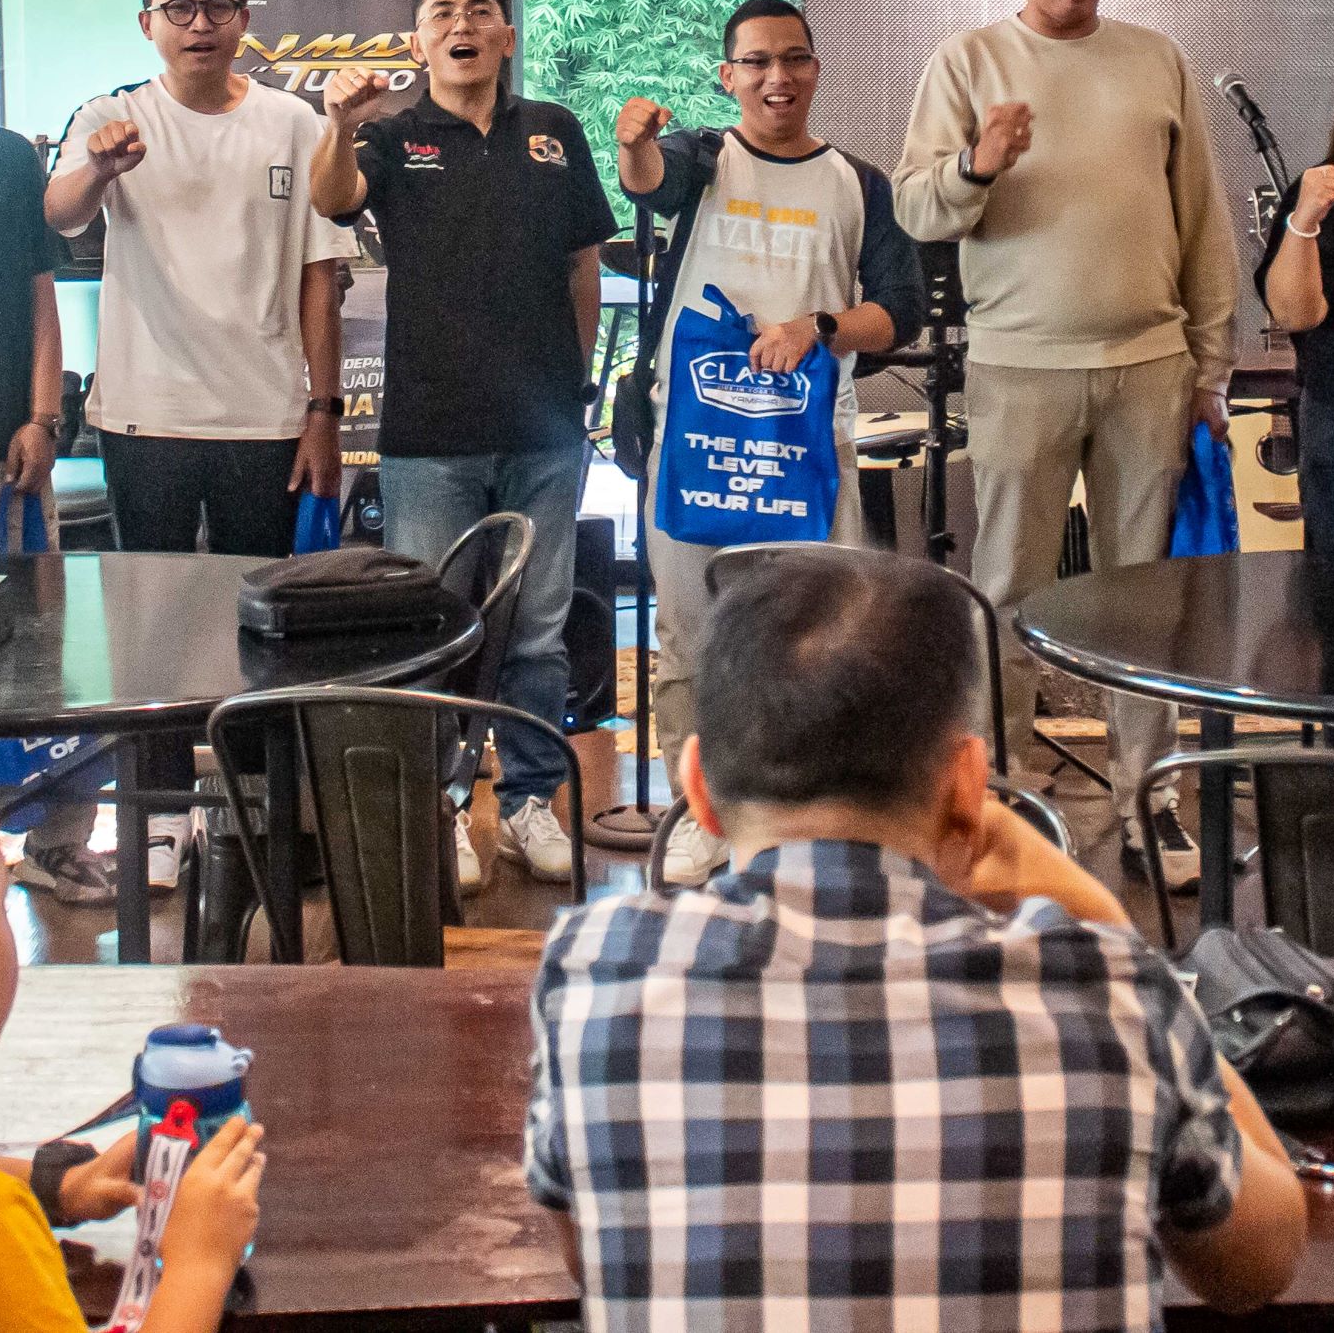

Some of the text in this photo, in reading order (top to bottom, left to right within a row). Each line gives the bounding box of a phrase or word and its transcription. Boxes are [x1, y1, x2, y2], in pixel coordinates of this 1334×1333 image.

[343, 357, 384, 369] DEPA
[684, 433, 808, 462] THE NEXT
[708, 454, 786, 478] LEVEL
[728, 476, 765, 493] OF
[679, 489, 808, 517] YOUR LIFE
